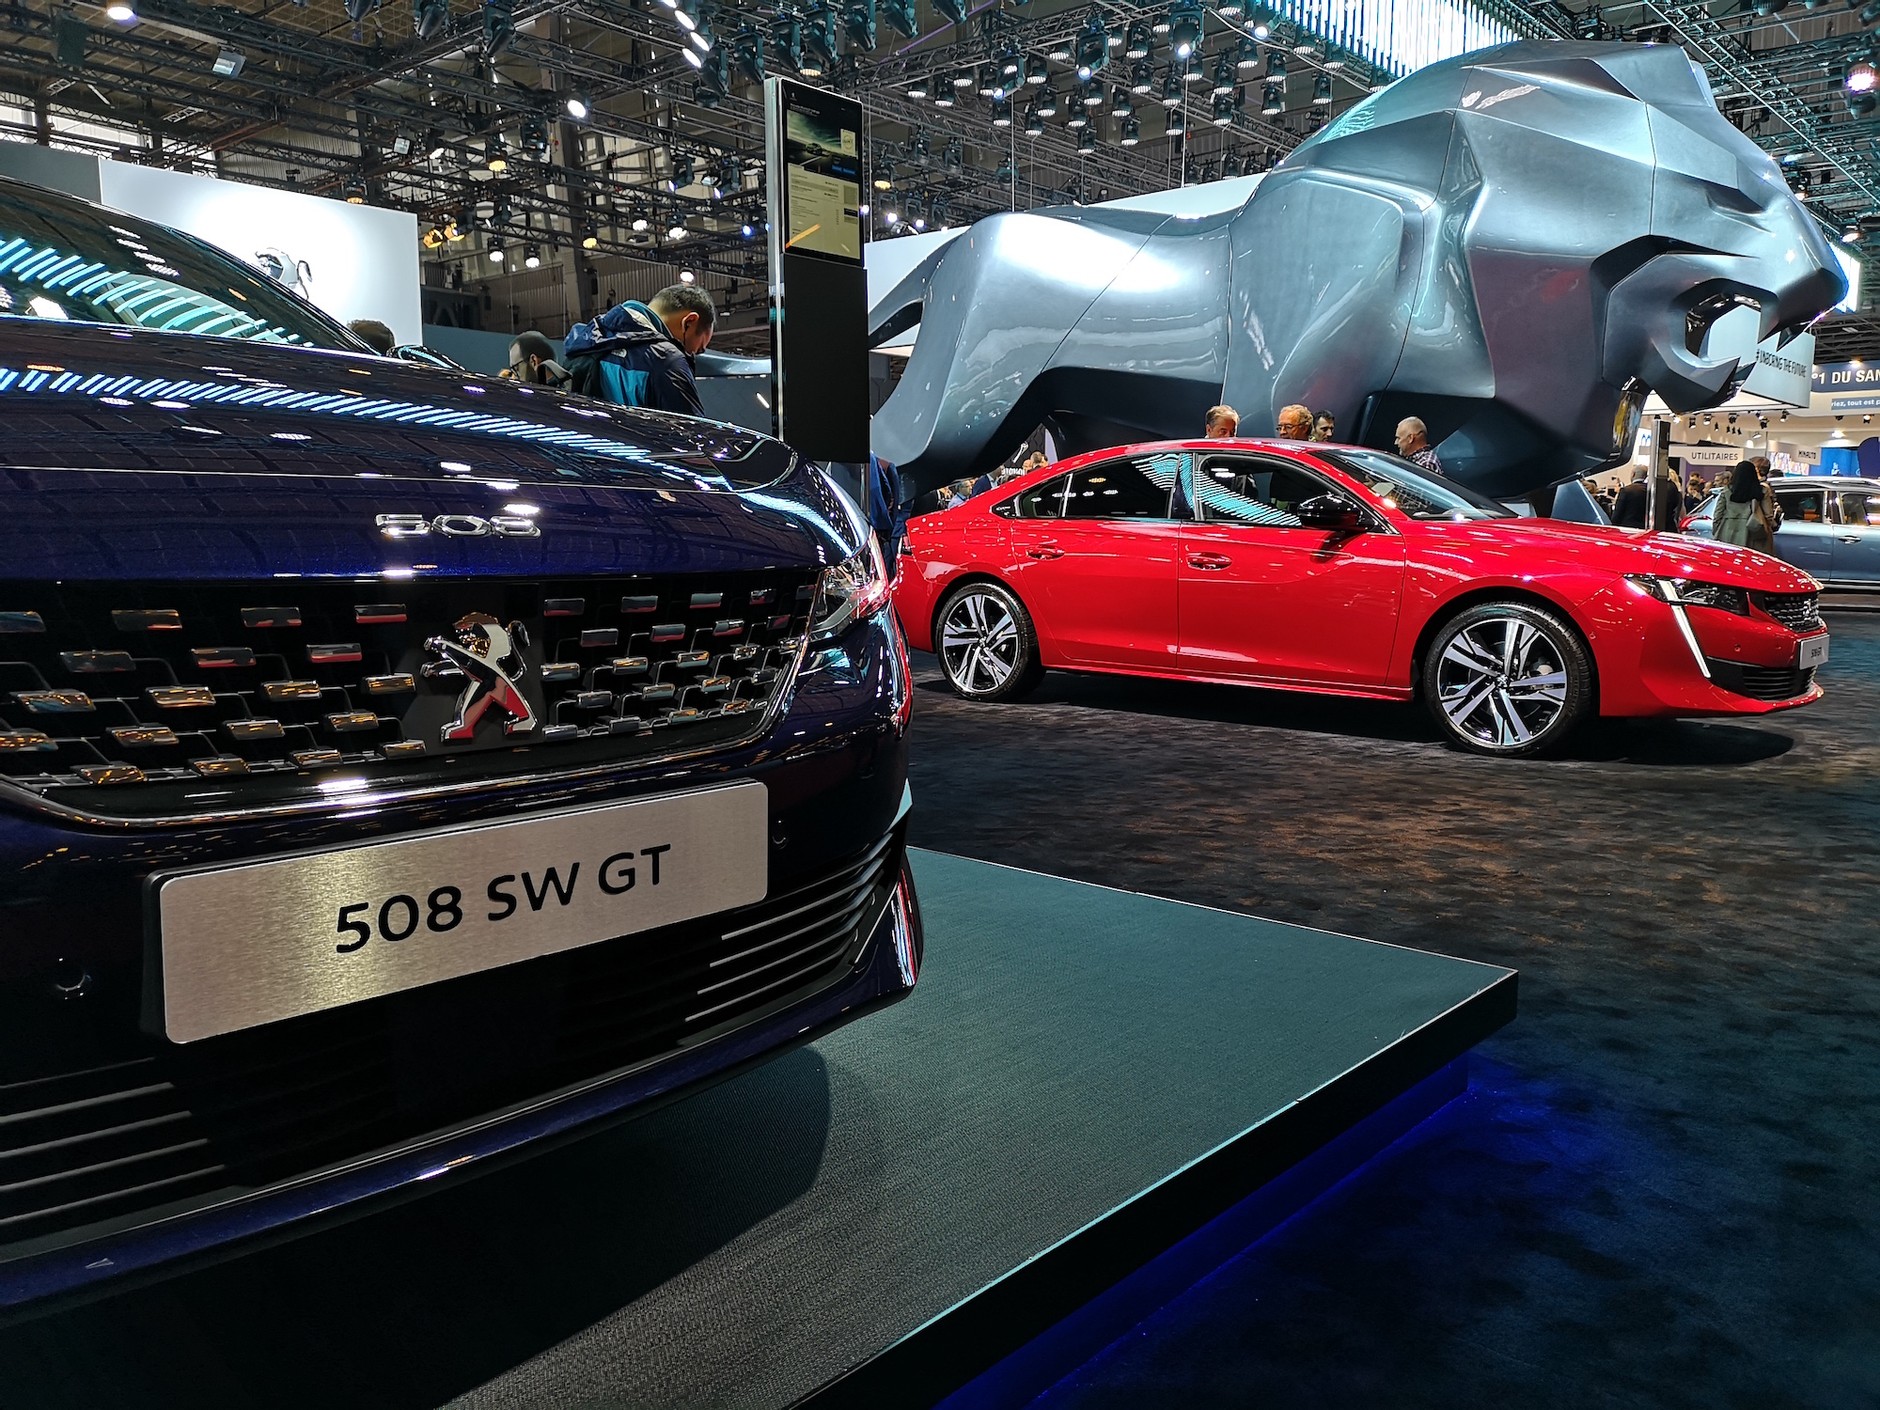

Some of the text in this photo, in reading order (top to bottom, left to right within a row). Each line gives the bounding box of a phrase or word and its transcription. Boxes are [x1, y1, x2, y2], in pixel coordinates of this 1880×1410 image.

[1831, 371, 1852, 384] DU
[1691, 452, 1739, 460] UTILITAIRES
[375, 513, 542, 538] 508
[335, 843, 671, 953] 508 SW GT
